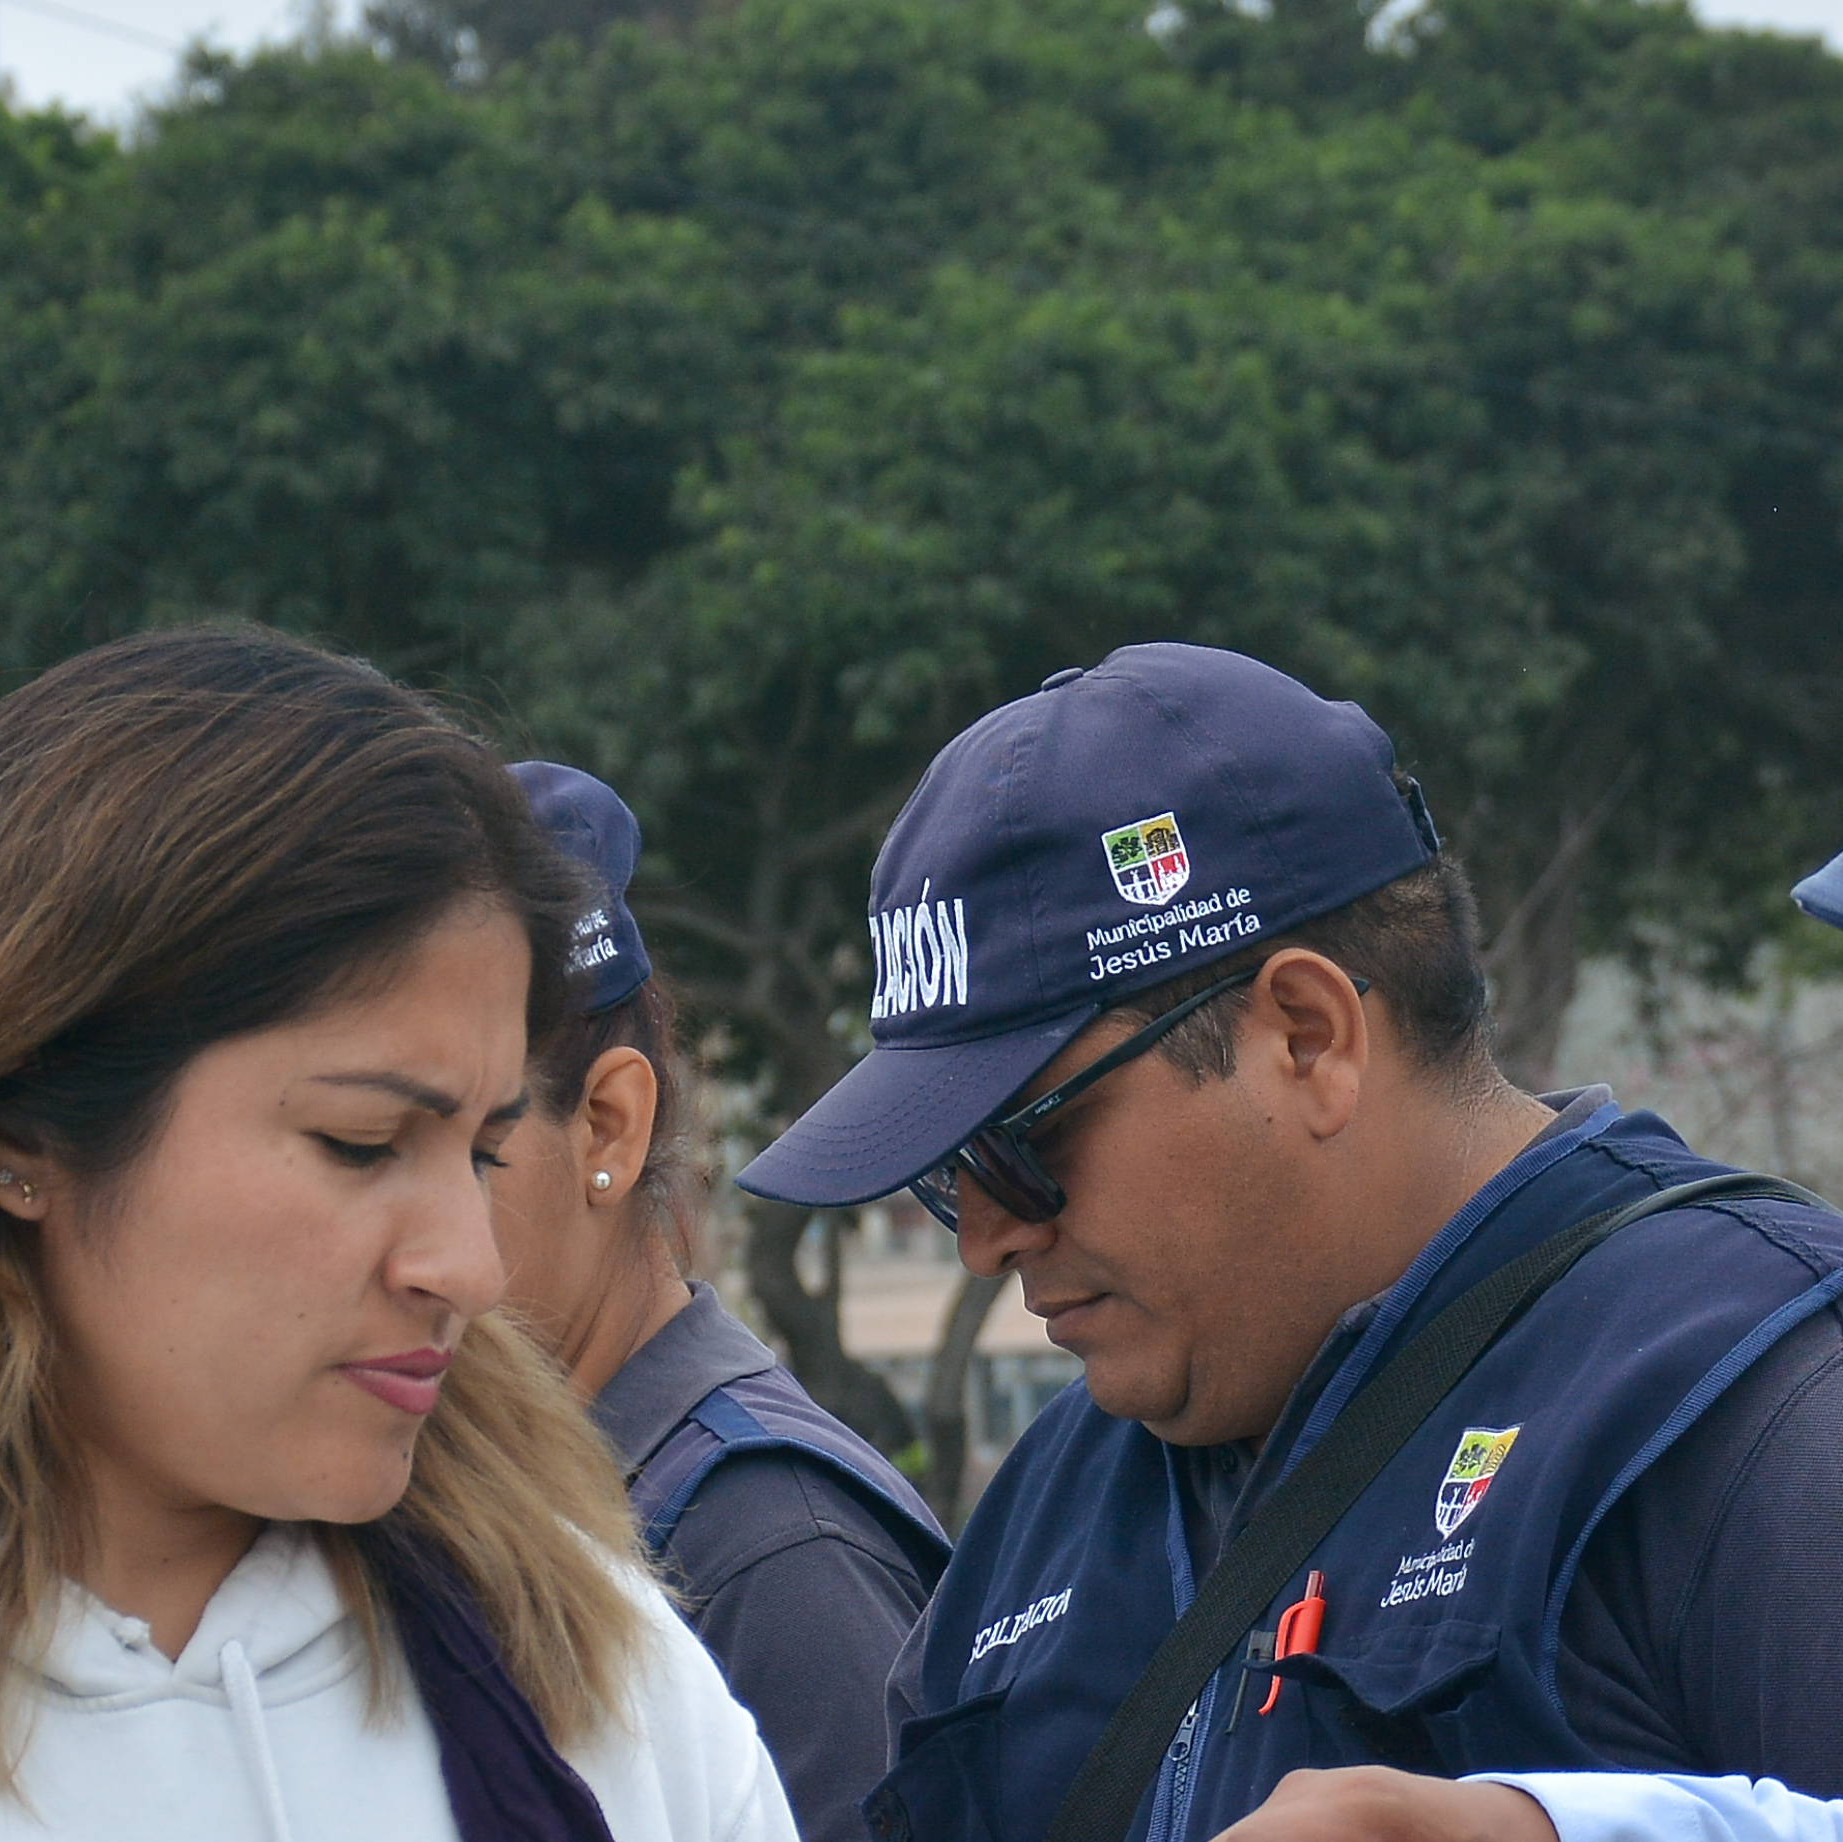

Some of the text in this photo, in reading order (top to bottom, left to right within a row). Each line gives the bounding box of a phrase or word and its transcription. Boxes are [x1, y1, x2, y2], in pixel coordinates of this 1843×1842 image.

[868, 877, 969, 1019] ZACIÓN
[1085, 888, 1252, 951] Municipalidad de
[1089, 911, 1261, 980] Jesús María
